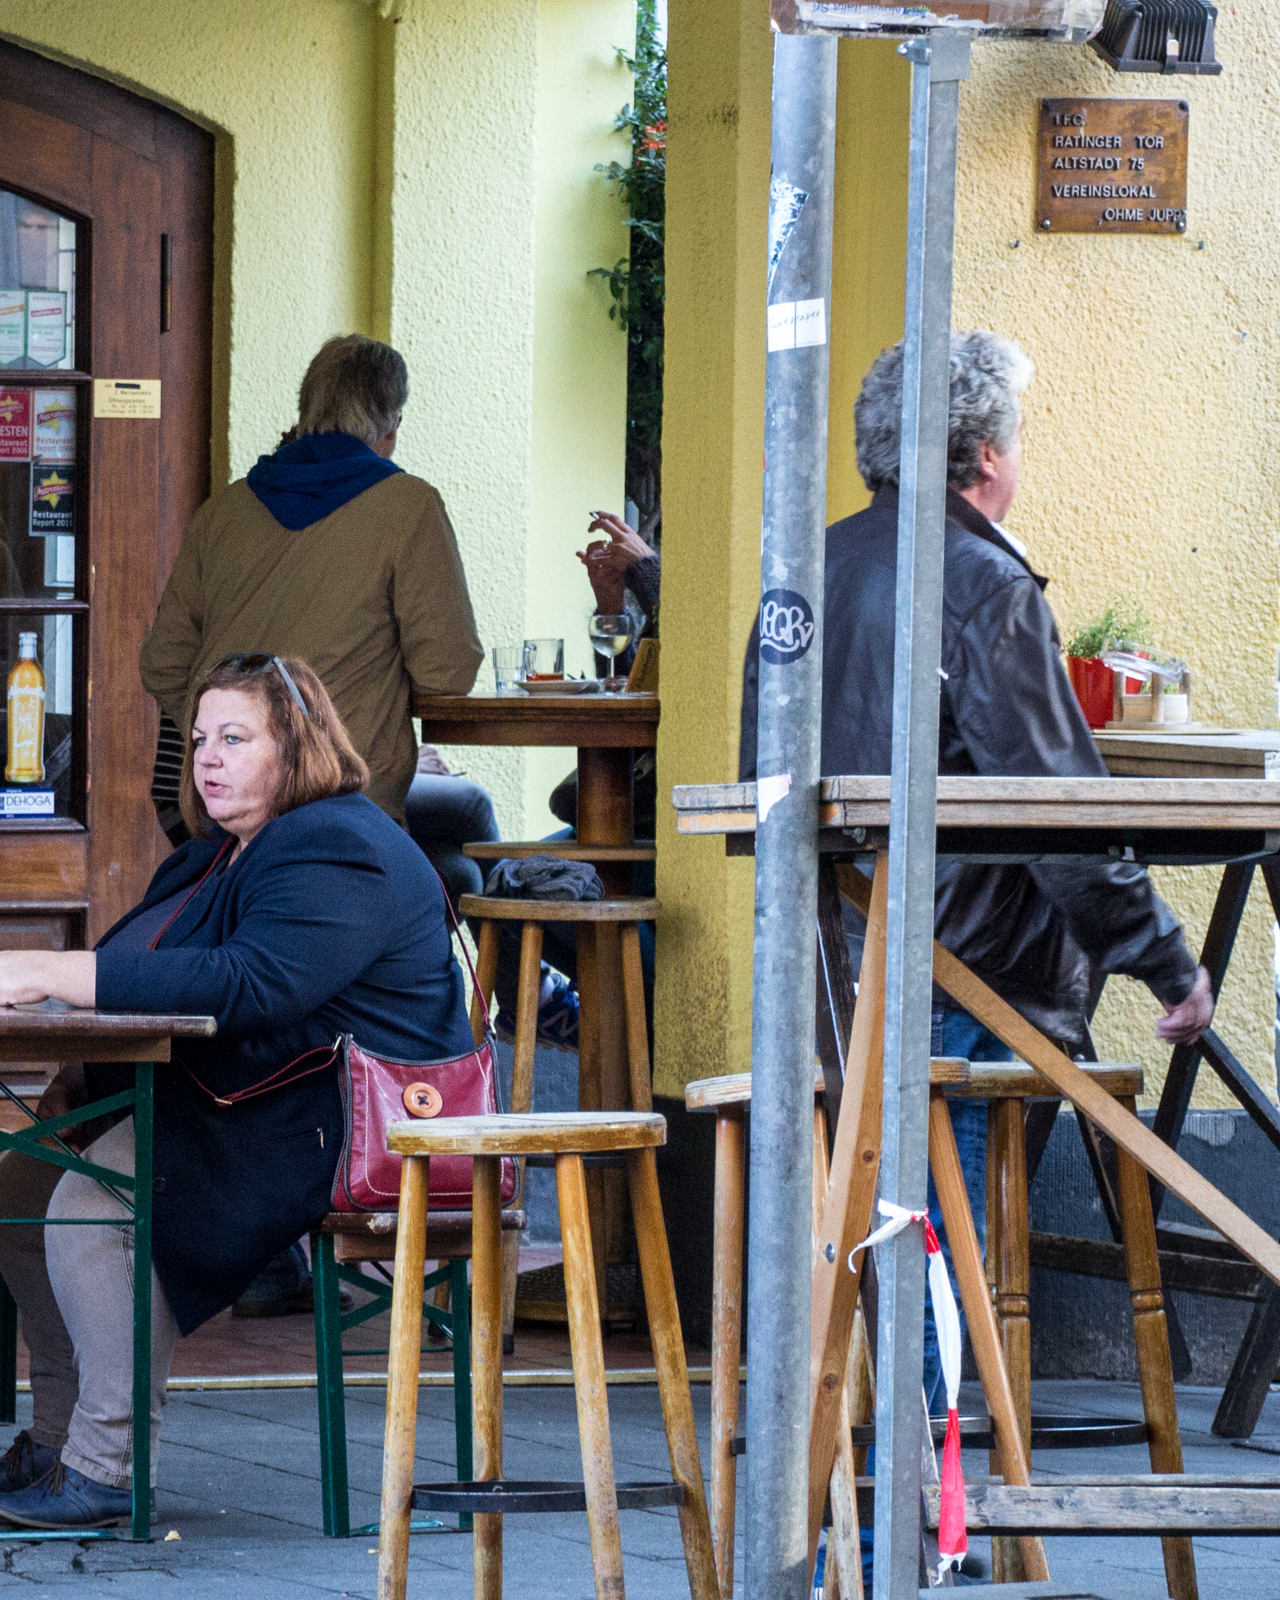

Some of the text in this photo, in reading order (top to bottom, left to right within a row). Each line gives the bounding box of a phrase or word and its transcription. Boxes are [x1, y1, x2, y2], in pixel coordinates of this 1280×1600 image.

[1054, 135, 1164, 149] RATINGER TOR
[1054, 157, 1145, 170] ALTSTADT 75
[1053, 185, 1156, 199] VEREINSLOKAL
[33, 510, 73, 519] Restaurant
[32, 519, 55, 528] Report
[6, 795, 51, 807] DEHOGA
